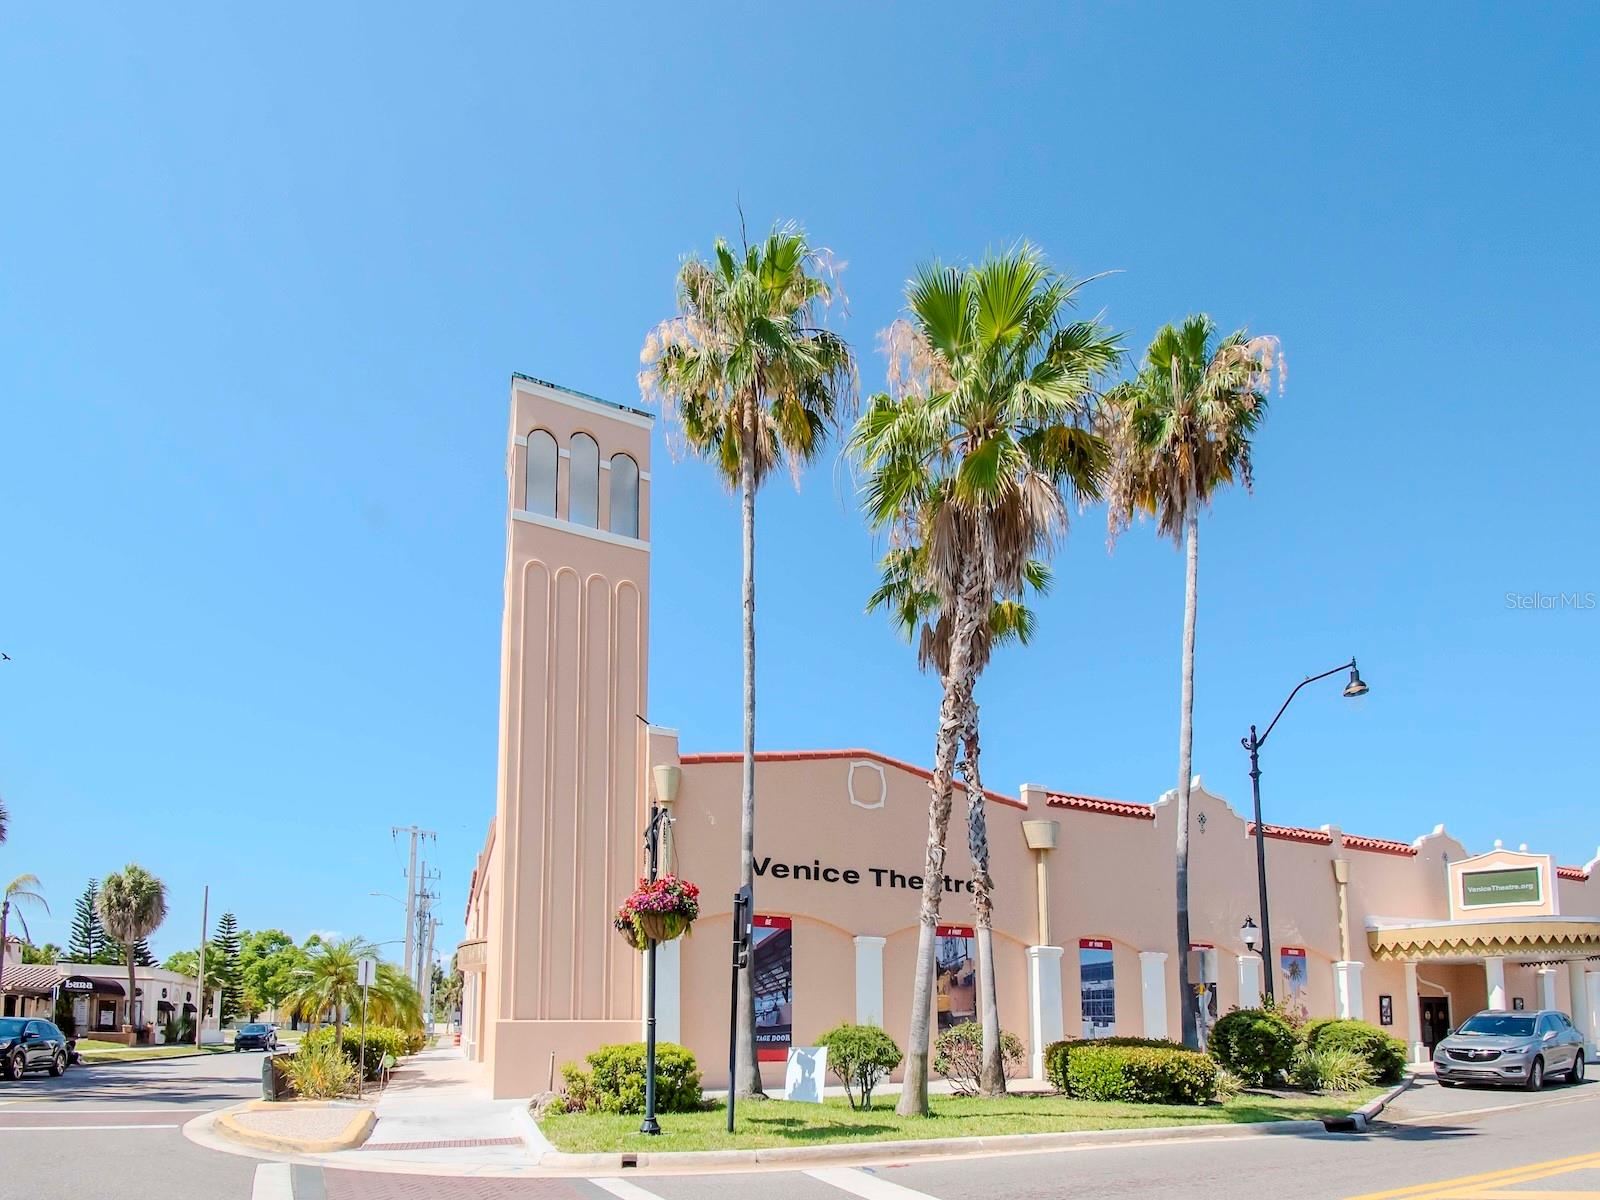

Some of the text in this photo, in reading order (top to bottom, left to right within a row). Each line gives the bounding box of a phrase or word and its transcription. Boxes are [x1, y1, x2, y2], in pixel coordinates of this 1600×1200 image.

[753, 857, 975, 893] Venice Thetre
[1467, 883, 1534, 893] VeniceTheatre.org
